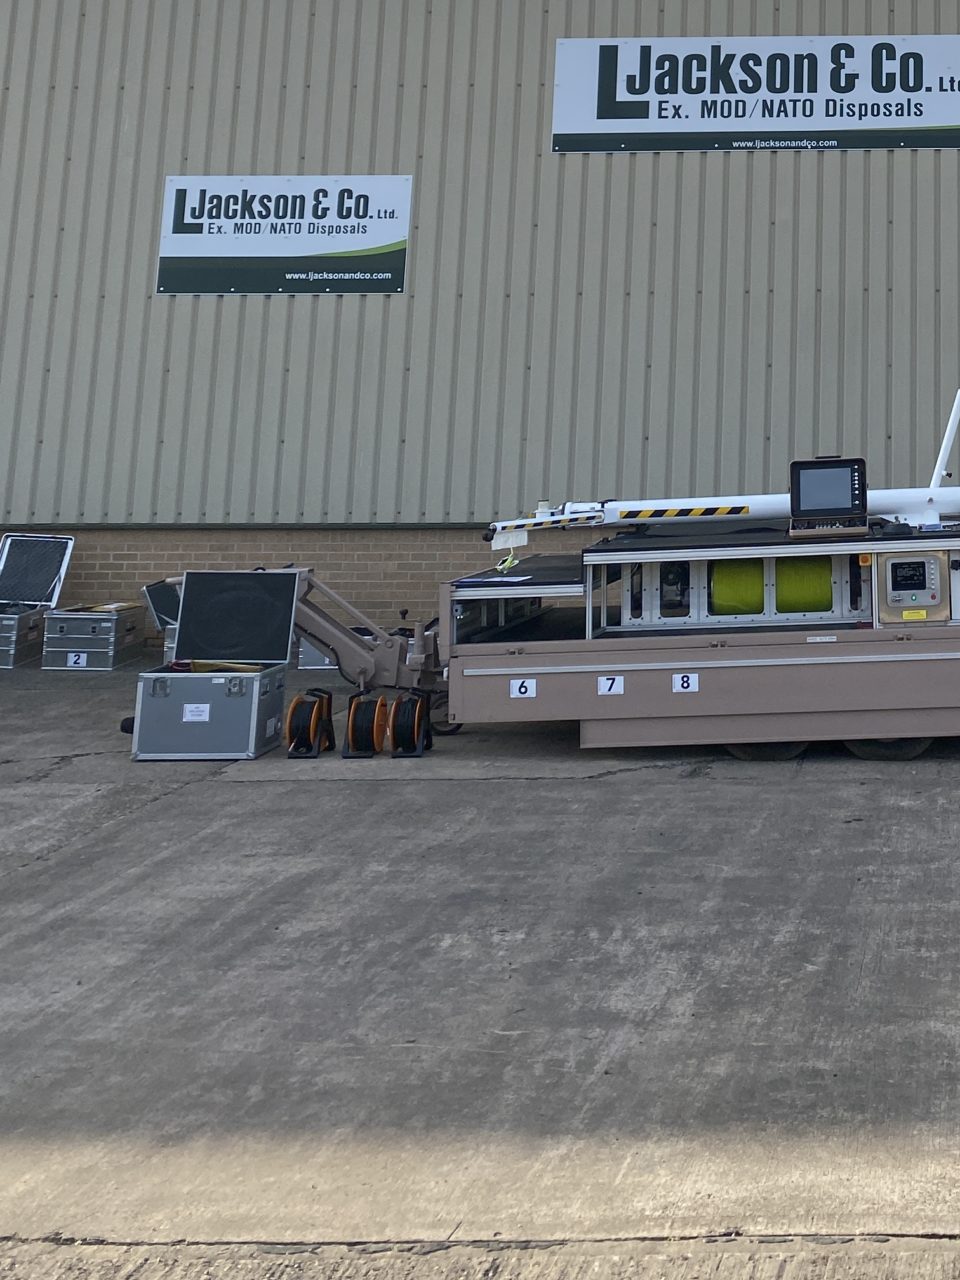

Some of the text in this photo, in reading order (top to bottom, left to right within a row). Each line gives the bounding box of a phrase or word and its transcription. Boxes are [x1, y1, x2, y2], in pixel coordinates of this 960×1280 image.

[829, 43, 859, 93] &
[871, 42, 932, 93] Co.
[658, 99, 923, 120] Ex. MOD/NATO Disposals
[732, 138, 838, 148] www.ljacksonandco.com
[312, 189, 329, 219] &
[337, 189, 373, 219] Co.
[377, 209, 398, 219] Ltd.
[208, 222, 367, 235] Ex. MOD/NATO Disposals
[286, 272, 391, 280] www.ljacksonandco.com
[72, 653, 81, 665] 2
[518, 680, 528, 695] 6
[606, 678, 616, 692] 7
[681, 675, 690, 689] 8
